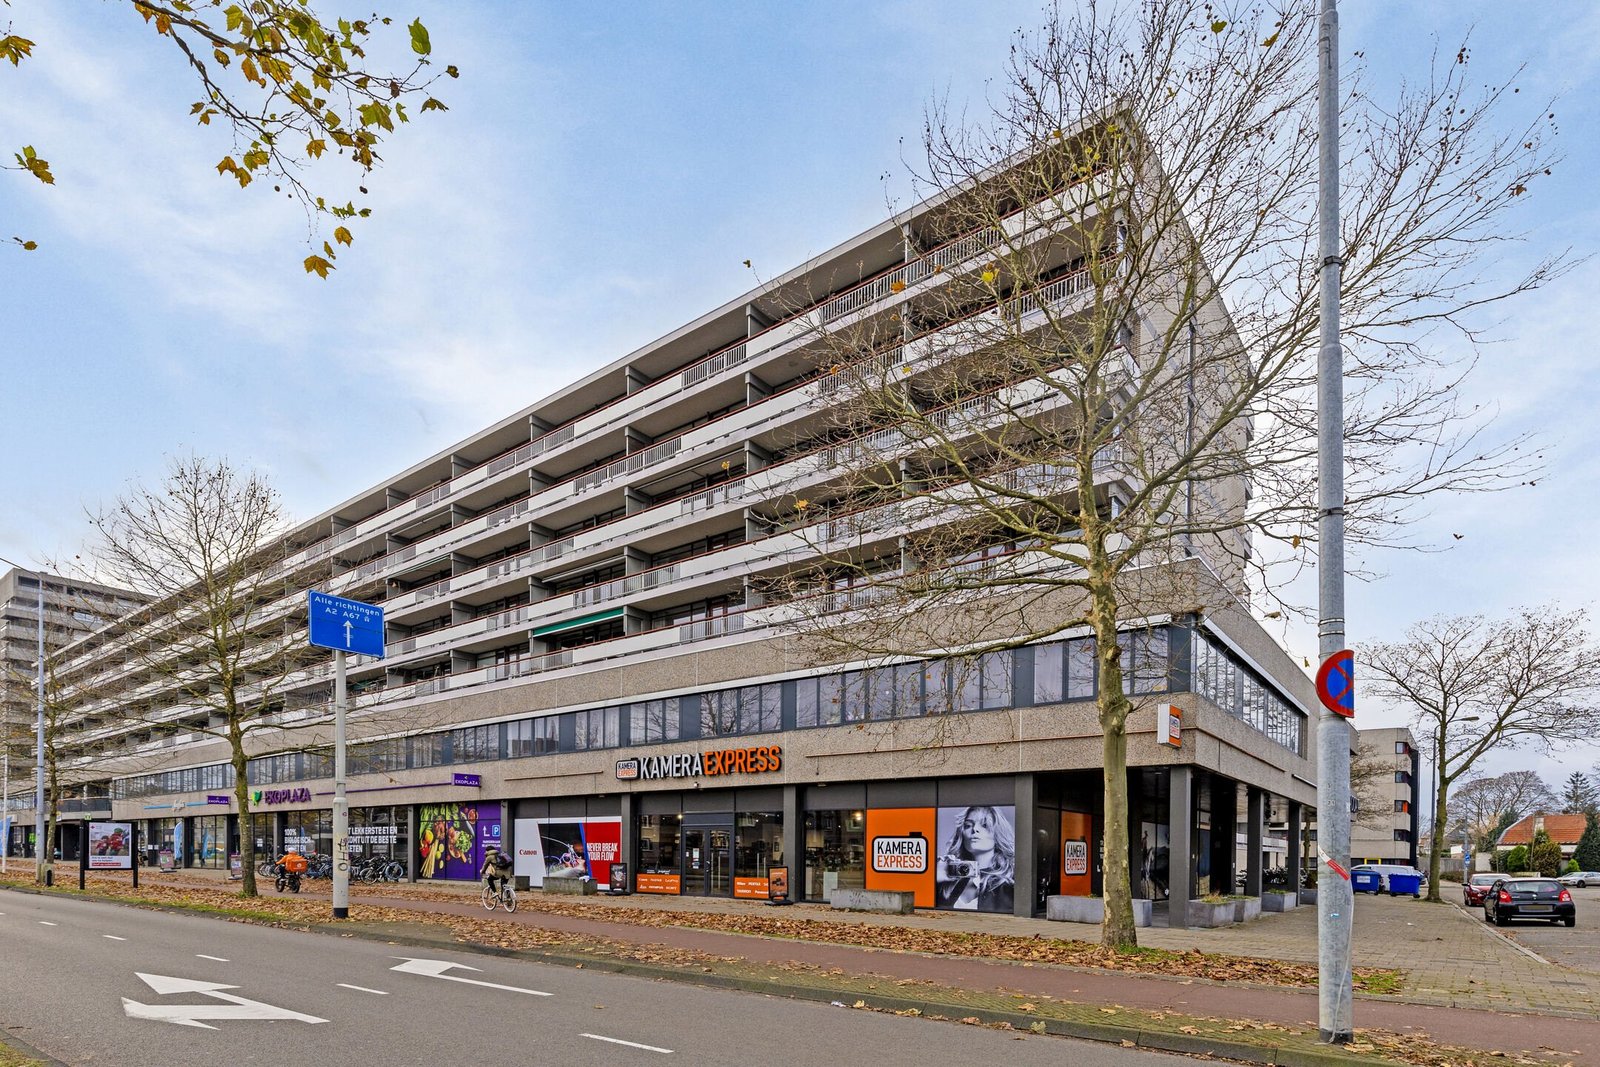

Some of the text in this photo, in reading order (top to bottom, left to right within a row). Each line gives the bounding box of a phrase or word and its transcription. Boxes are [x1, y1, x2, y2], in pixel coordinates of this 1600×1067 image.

[314, 596, 380, 616] Alle richtingen
[325, 607, 360, 620] A2 A67
[640, 746, 780, 779] KAMERA EXPRESS
[618, 768, 637, 776] EXPRESS
[264, 787, 311, 805] EKOPLAZA
[519, 848, 538, 856] Canon
[586, 842, 618, 852] NEVER BREAK
[877, 841, 922, 855] KAMERA
[1066, 844, 1086, 857] KAMERA
[588, 851, 615, 861] YOUR FLOW
[877, 855, 922, 869] EXPRESS
[1066, 858, 1086, 871] EXPRESS
